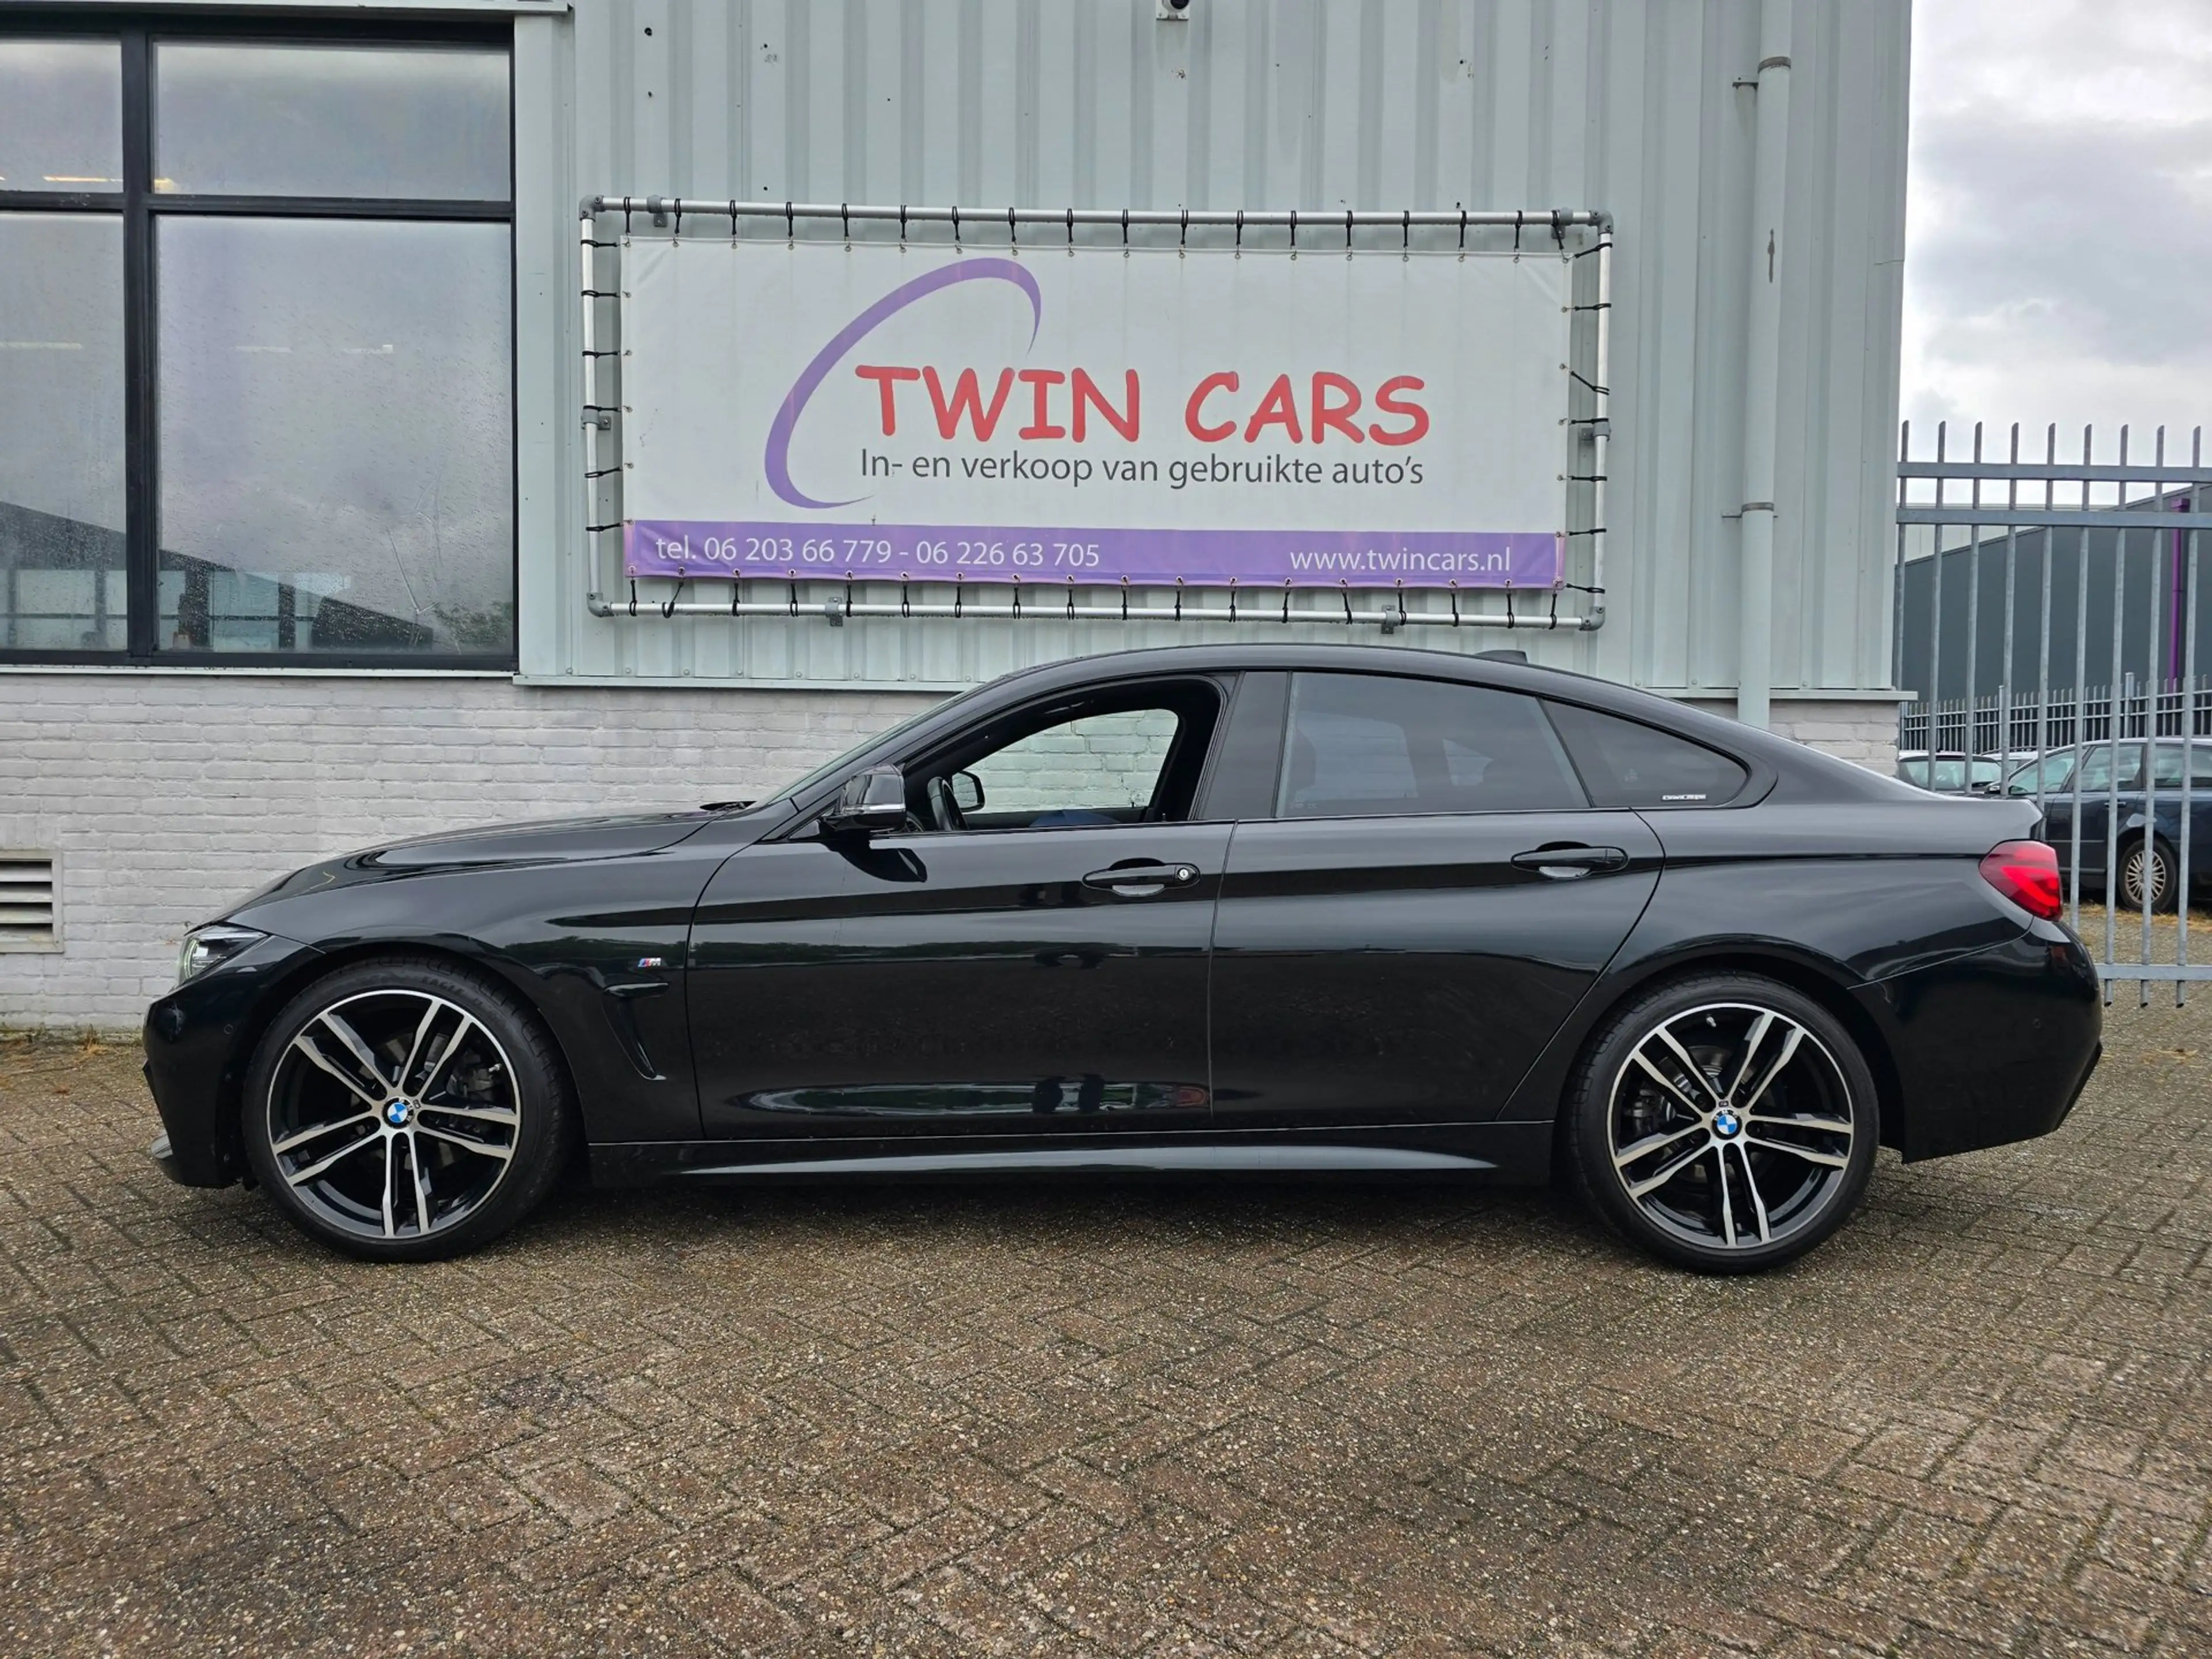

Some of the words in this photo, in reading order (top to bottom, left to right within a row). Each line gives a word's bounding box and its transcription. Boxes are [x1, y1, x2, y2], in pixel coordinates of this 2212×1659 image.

[856, 365, 1141, 444] TWIN
[1184, 372, 1430, 446] CARS
[862, 448, 903, 477] In-
[912, 456, 950, 478] en
[960, 449, 1093, 488] verkoop
[1101, 460, 1158, 482] van
[1168, 452, 1323, 490] gebruikte
[1332, 455, 1423, 484] auto's
[655, 534, 697, 560] tel.
[704, 537, 737, 561] 06
[745, 537, 794, 562] 203
[802, 539, 835, 562] 66
[843, 539, 892, 563] 779
[916, 540, 949, 565] 06
[956, 541, 1005, 566] 226
[1012, 543, 1044, 566] 63
[1052, 543, 1100, 567] 705
[1289, 546, 1510, 571] www.twincars.nl
